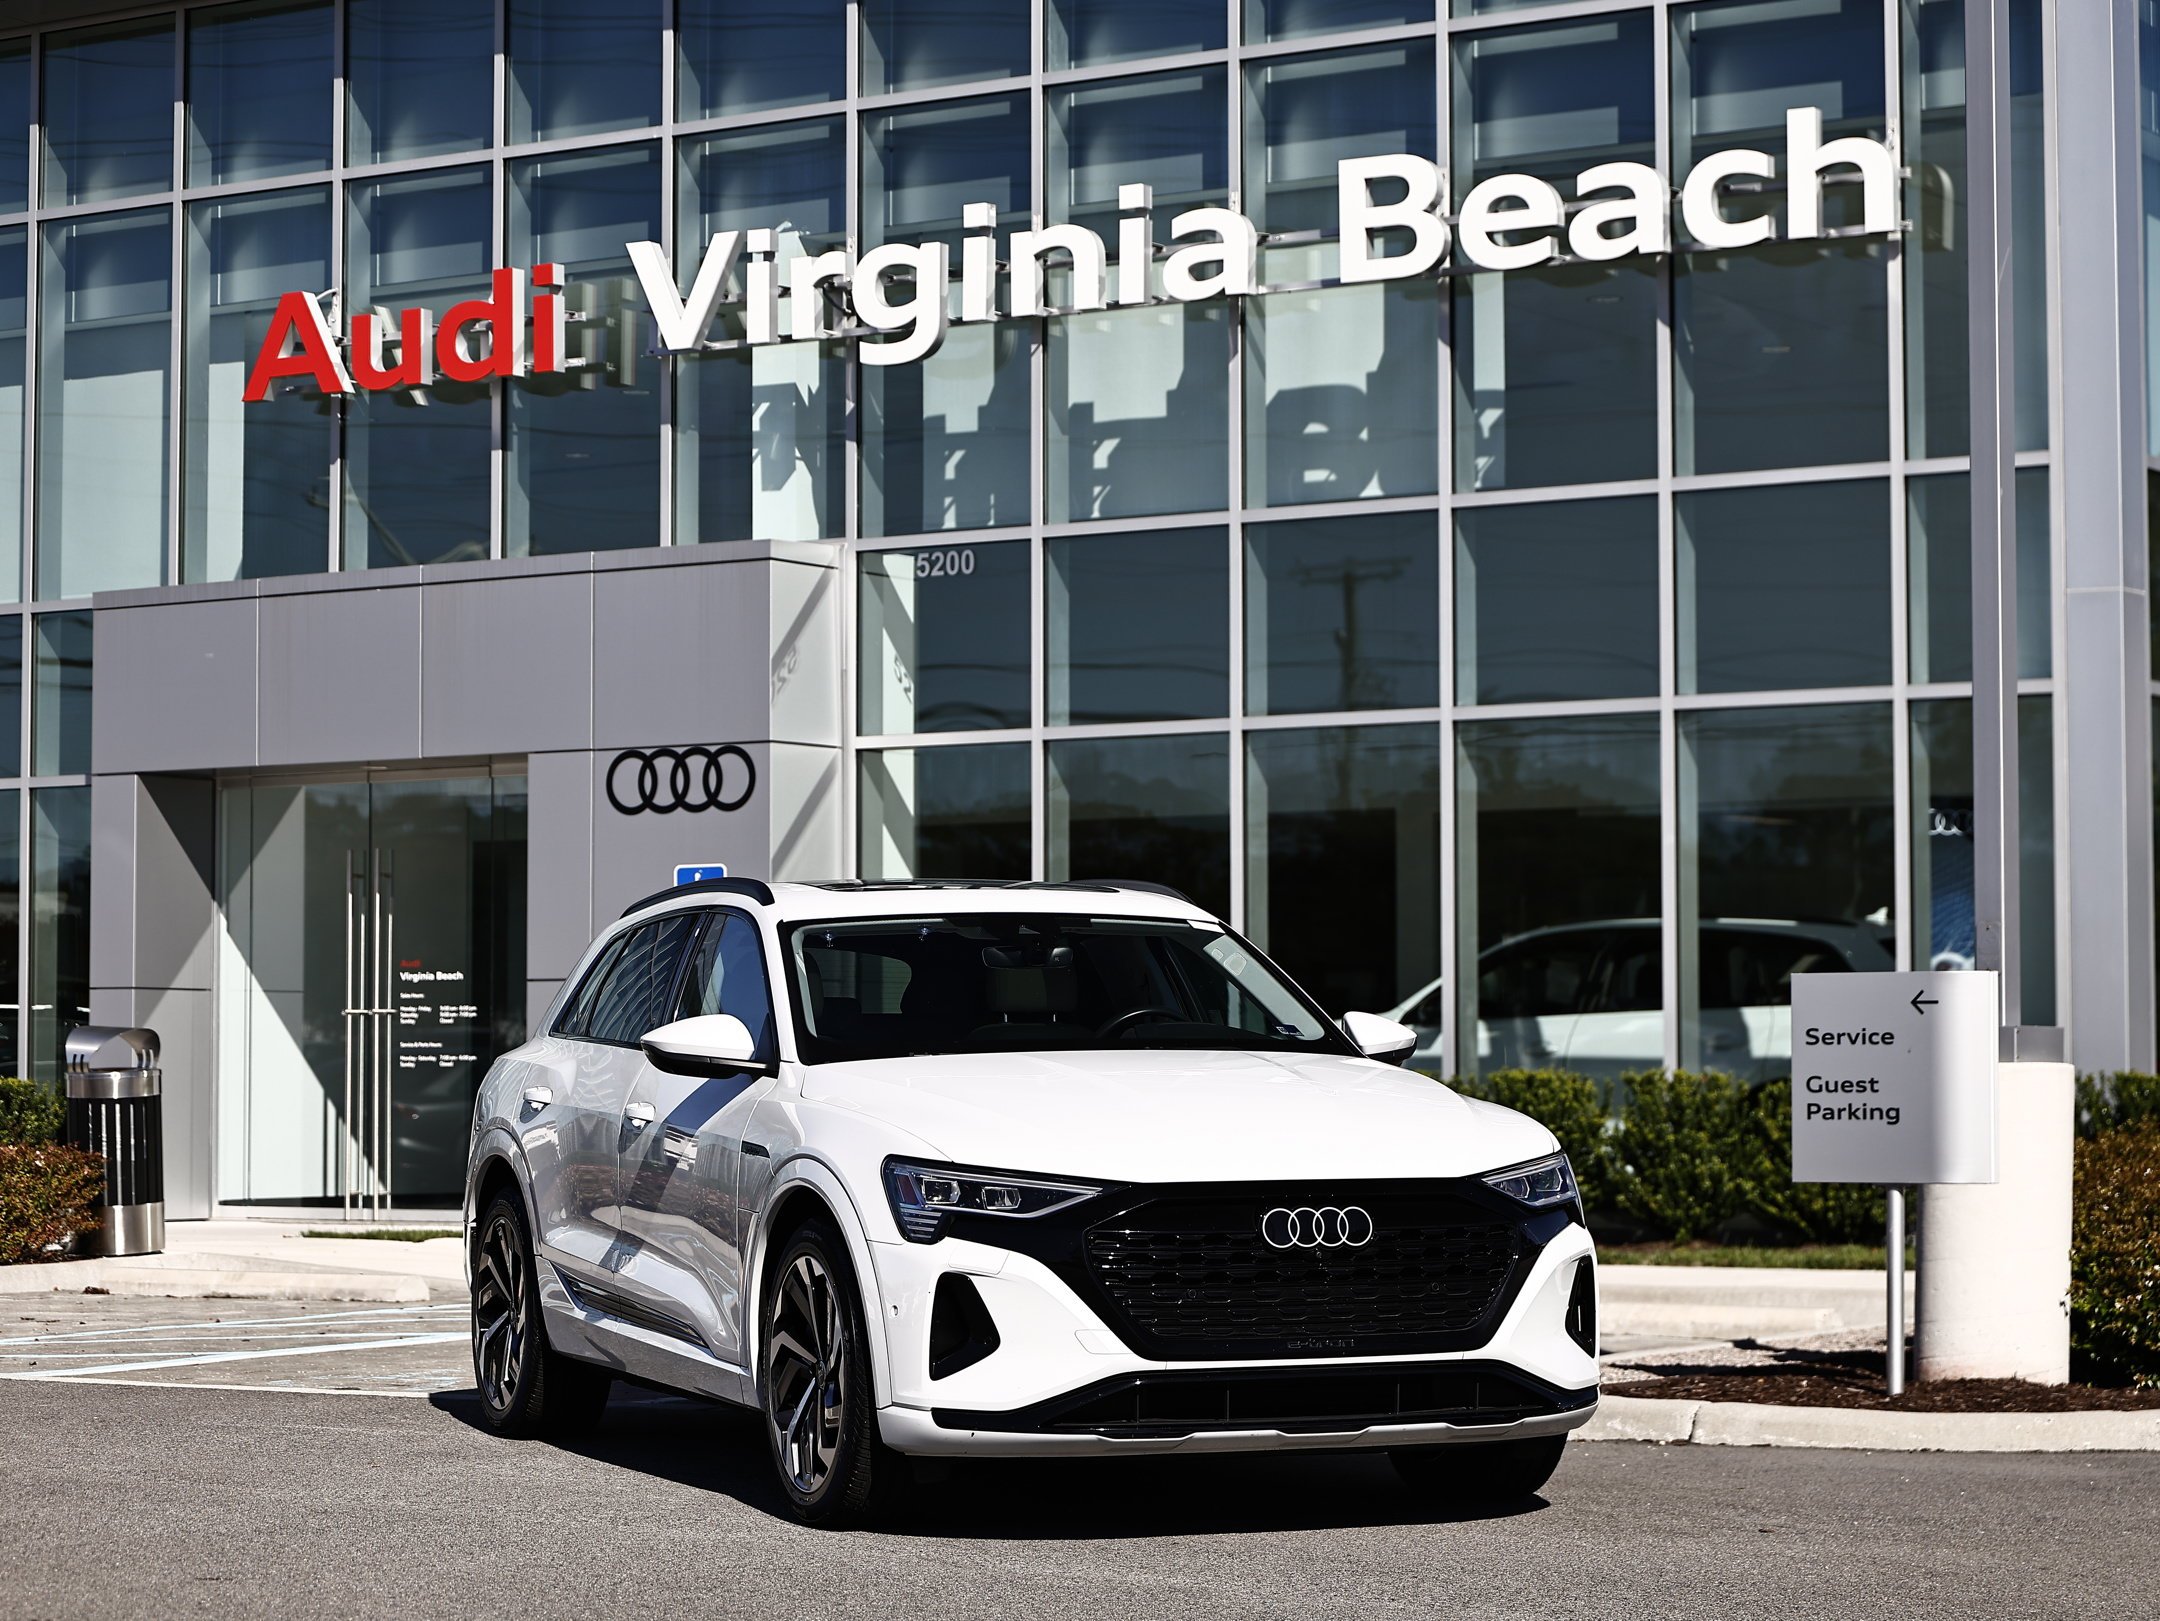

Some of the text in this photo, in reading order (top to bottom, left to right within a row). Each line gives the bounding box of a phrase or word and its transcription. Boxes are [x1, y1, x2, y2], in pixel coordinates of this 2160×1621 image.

[242, 105, 1899, 402] Audi Virginia Beach
[916, 549, 975, 577] 5200
[400, 971, 464, 983] Virginia Beach
[1805, 1028, 1895, 1046] Service
[1805, 1075, 1880, 1094] Guest
[1806, 1102, 1901, 1125] Parking
